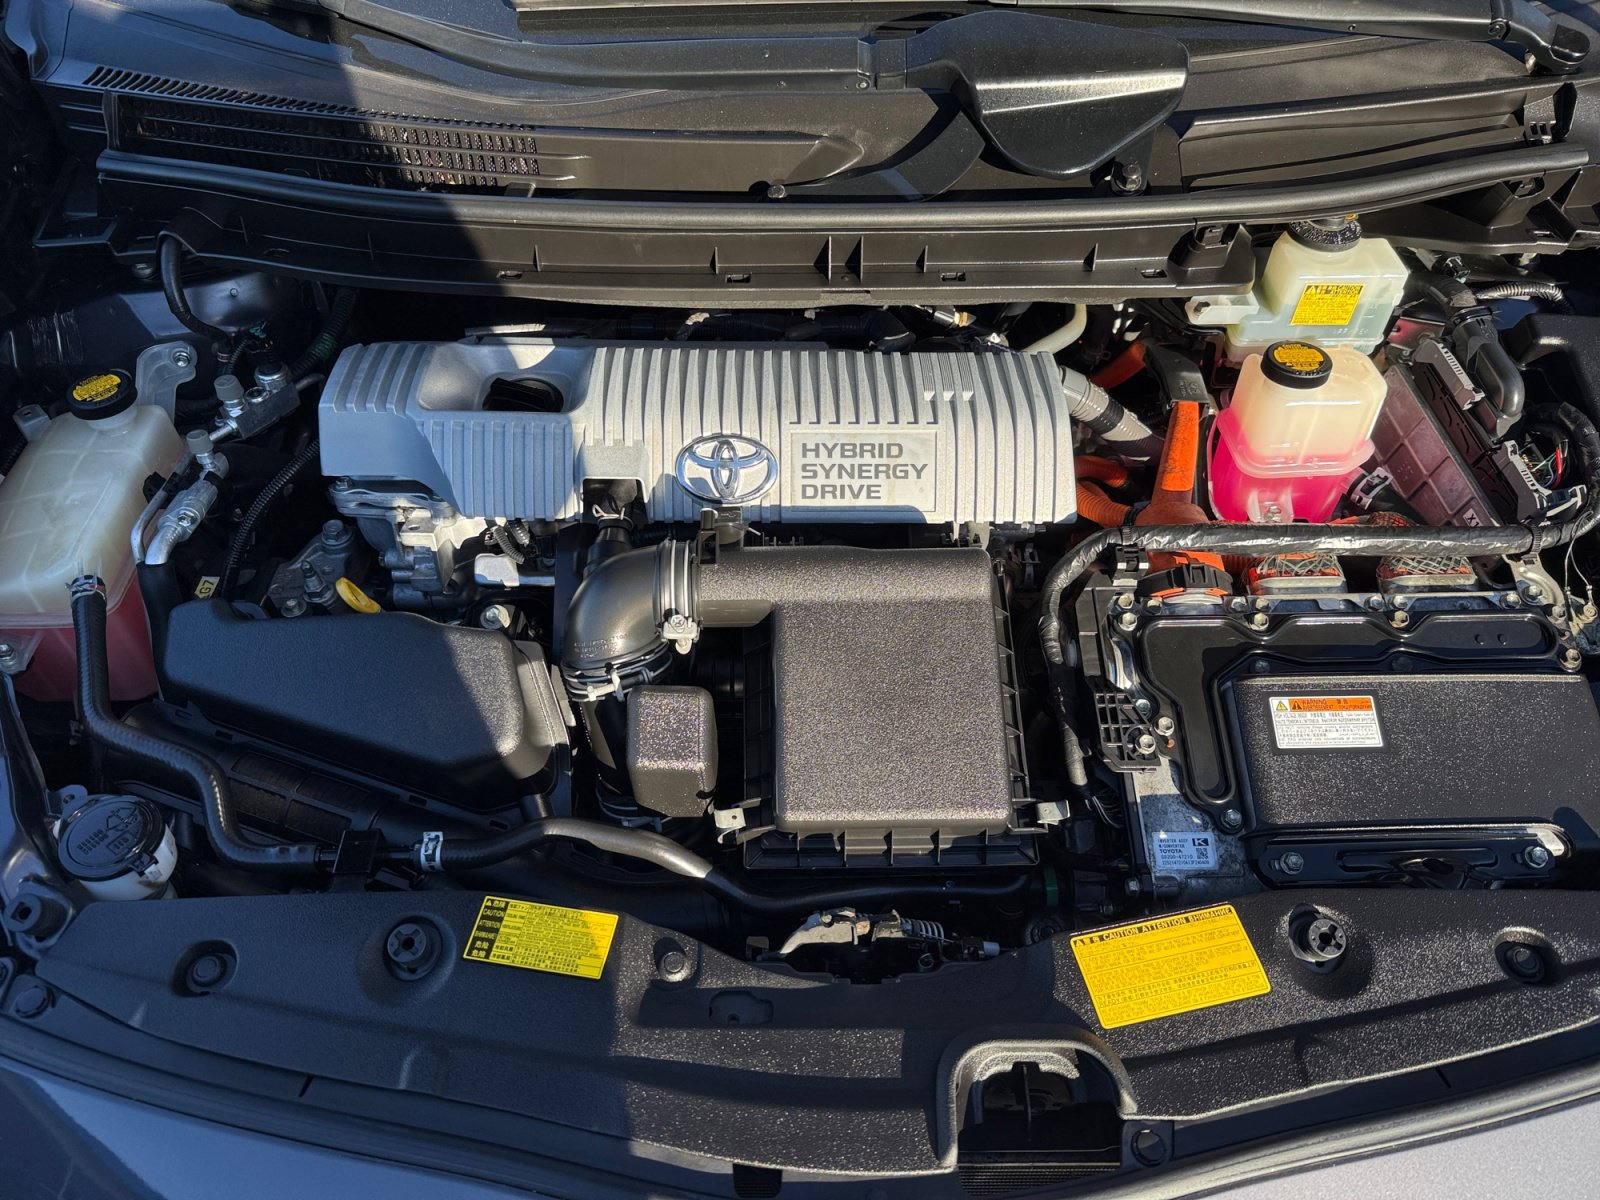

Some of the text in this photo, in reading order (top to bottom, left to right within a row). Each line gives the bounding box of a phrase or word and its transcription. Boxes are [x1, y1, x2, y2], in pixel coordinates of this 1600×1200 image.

[801, 442, 904, 459] HYBRID
[801, 463, 929, 480] SYNERGY
[801, 484, 882, 500] DRIVE
[199, 579, 214, 594] G7
[483, 908, 504, 917] CAUTION
[479, 919, 501, 929] ATTENTION
[1104, 928, 1139, 940] CAUTION
[1142, 917, 1186, 932] ATTENTION
[1189, 908, 1232, 922] ВНИМАНИЕ
